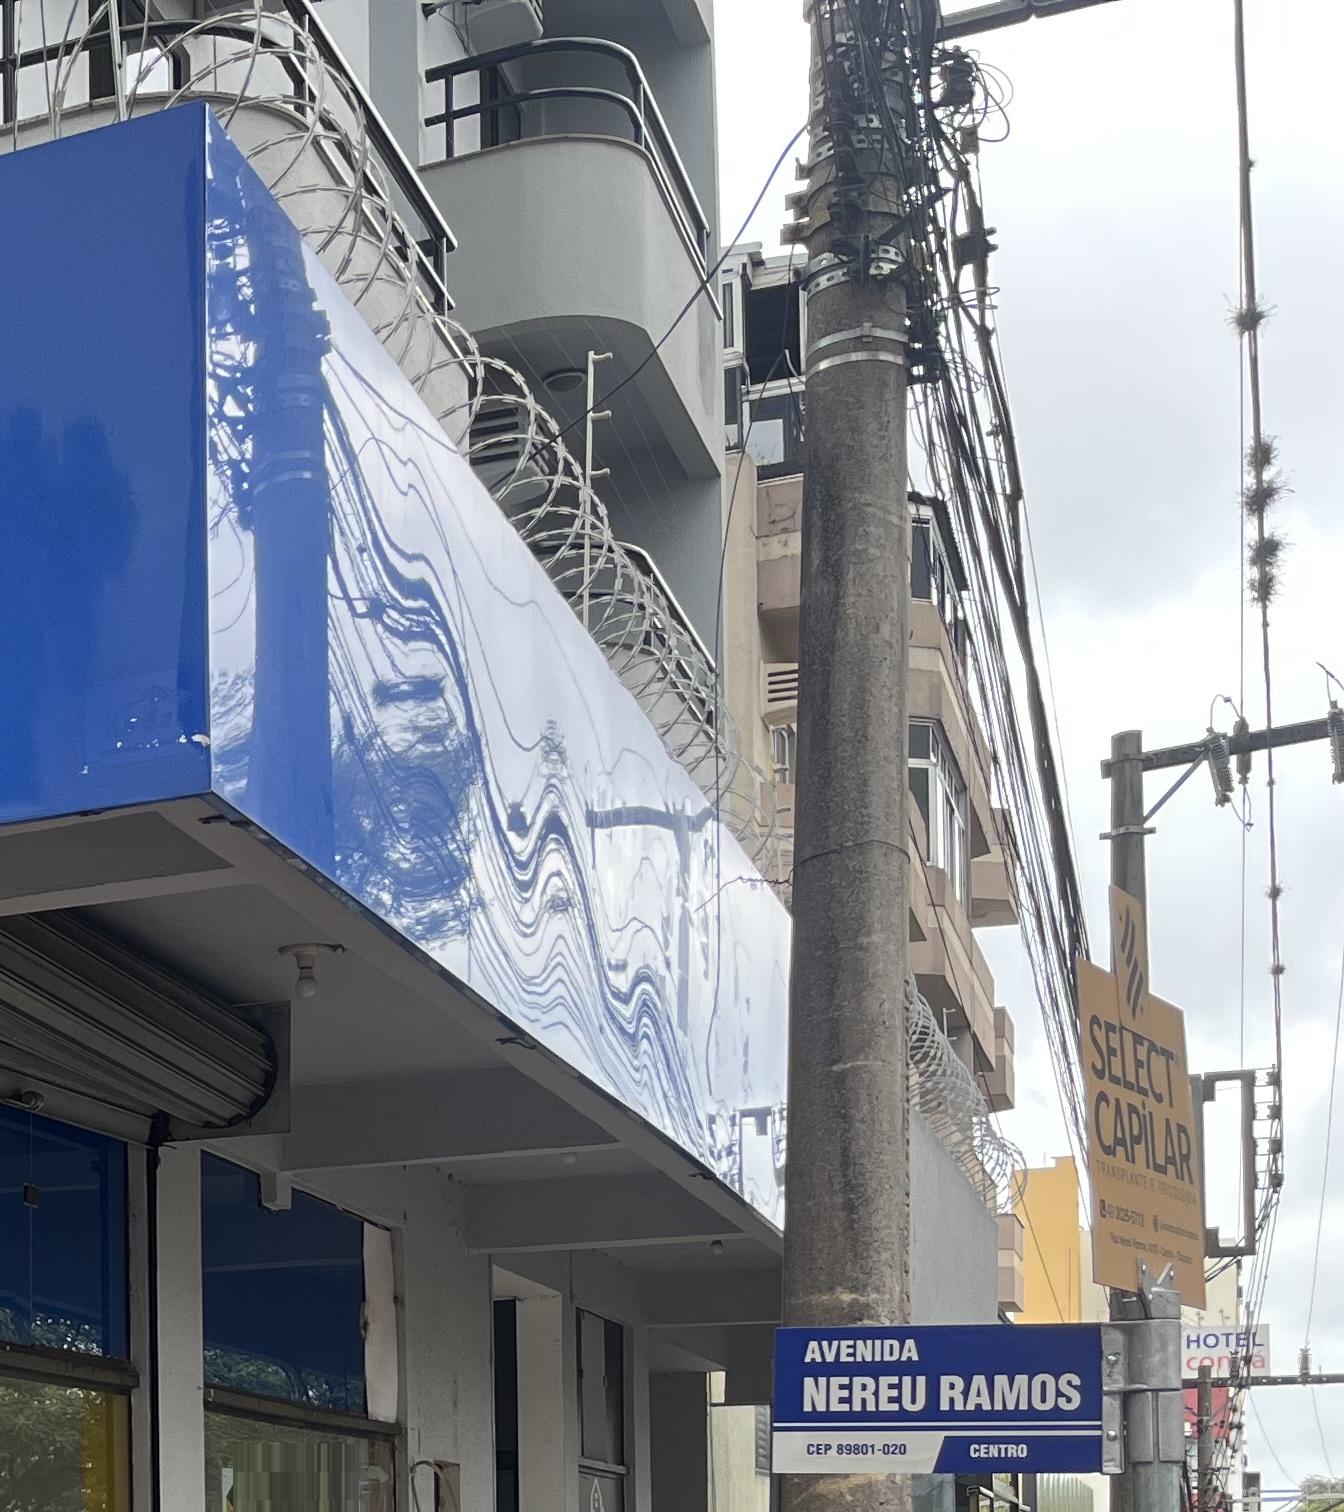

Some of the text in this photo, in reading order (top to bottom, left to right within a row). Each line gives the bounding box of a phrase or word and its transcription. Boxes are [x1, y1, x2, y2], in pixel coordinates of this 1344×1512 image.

[1089, 1014, 1174, 1108] SELECT
[804, 1338, 919, 1363] AVENIDA
[1186, 1332, 1265, 1350] HOTEL
[803, 1373, 1082, 1412] NEREU RAMOS
[807, 1443, 907, 1456] CEP 89801-020
[969, 1443, 1028, 1458] CENTRO
